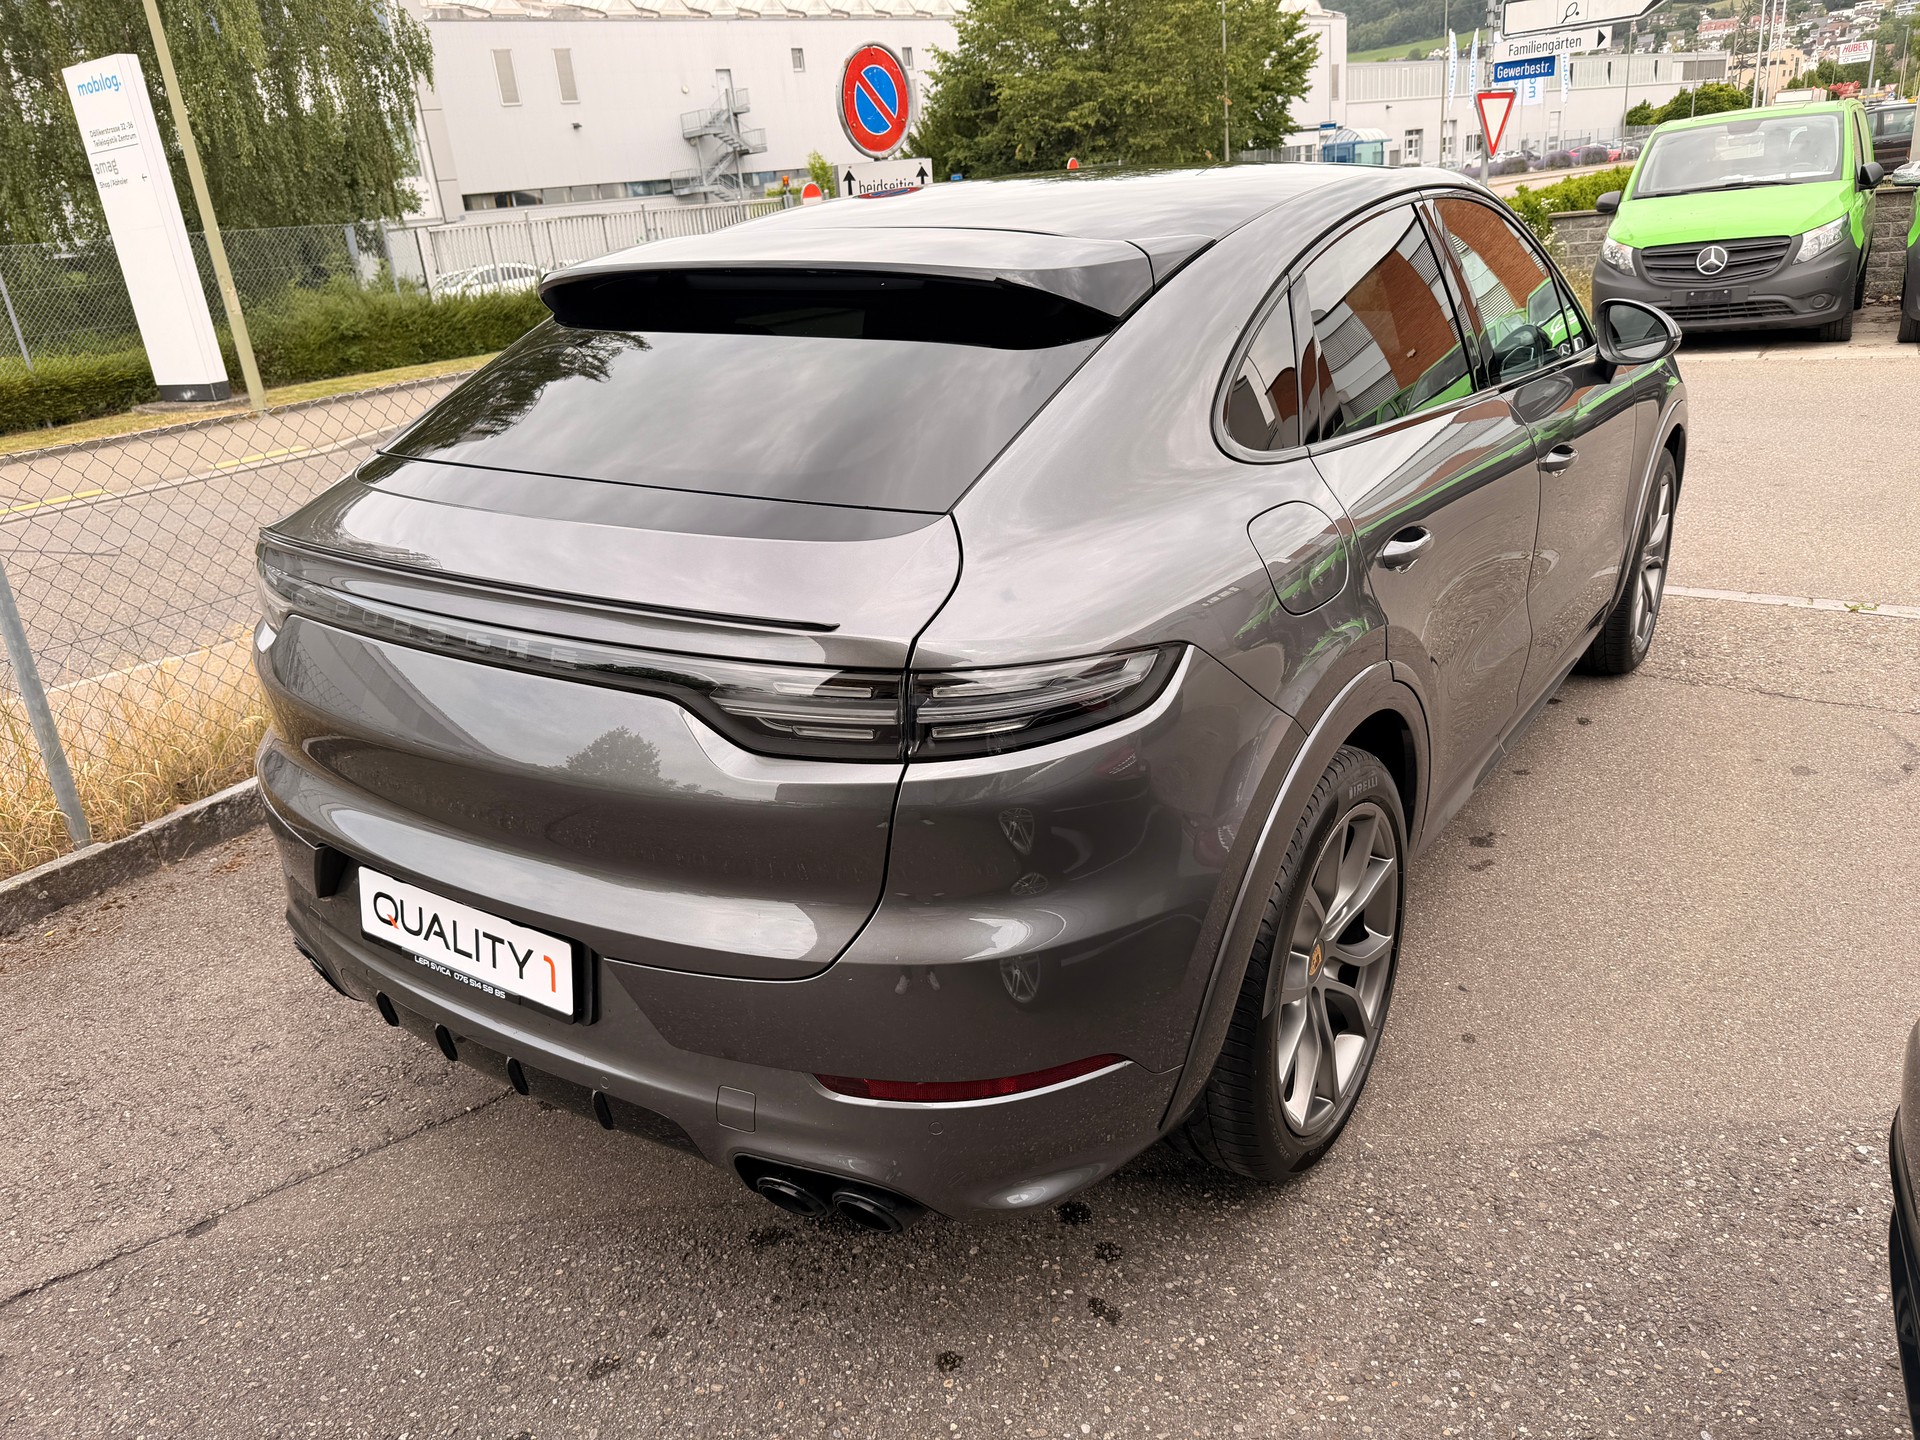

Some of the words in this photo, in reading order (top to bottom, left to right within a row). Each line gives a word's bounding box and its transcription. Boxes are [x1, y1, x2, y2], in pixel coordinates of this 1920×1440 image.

[1508, 36, 1582, 57] Familiengärten
[1842, 42, 1869, 53] HUBER
[1497, 62, 1552, 79] Gewerbestr.
[77, 72, 122, 96] mobilog.
[117, 133, 137, 142] Zentrum
[94, 158, 119, 175] amag
[334, 600, 578, 671] PORSCHE
[1348, 776, 1378, 800] PIRELLI
[373, 891, 534, 980] QUALITY
[414, 955, 430, 967] LEPI
[430, 962, 452, 977] SVICA
[453, 972, 469, 984] 076
[469, 978, 482, 989] 514
